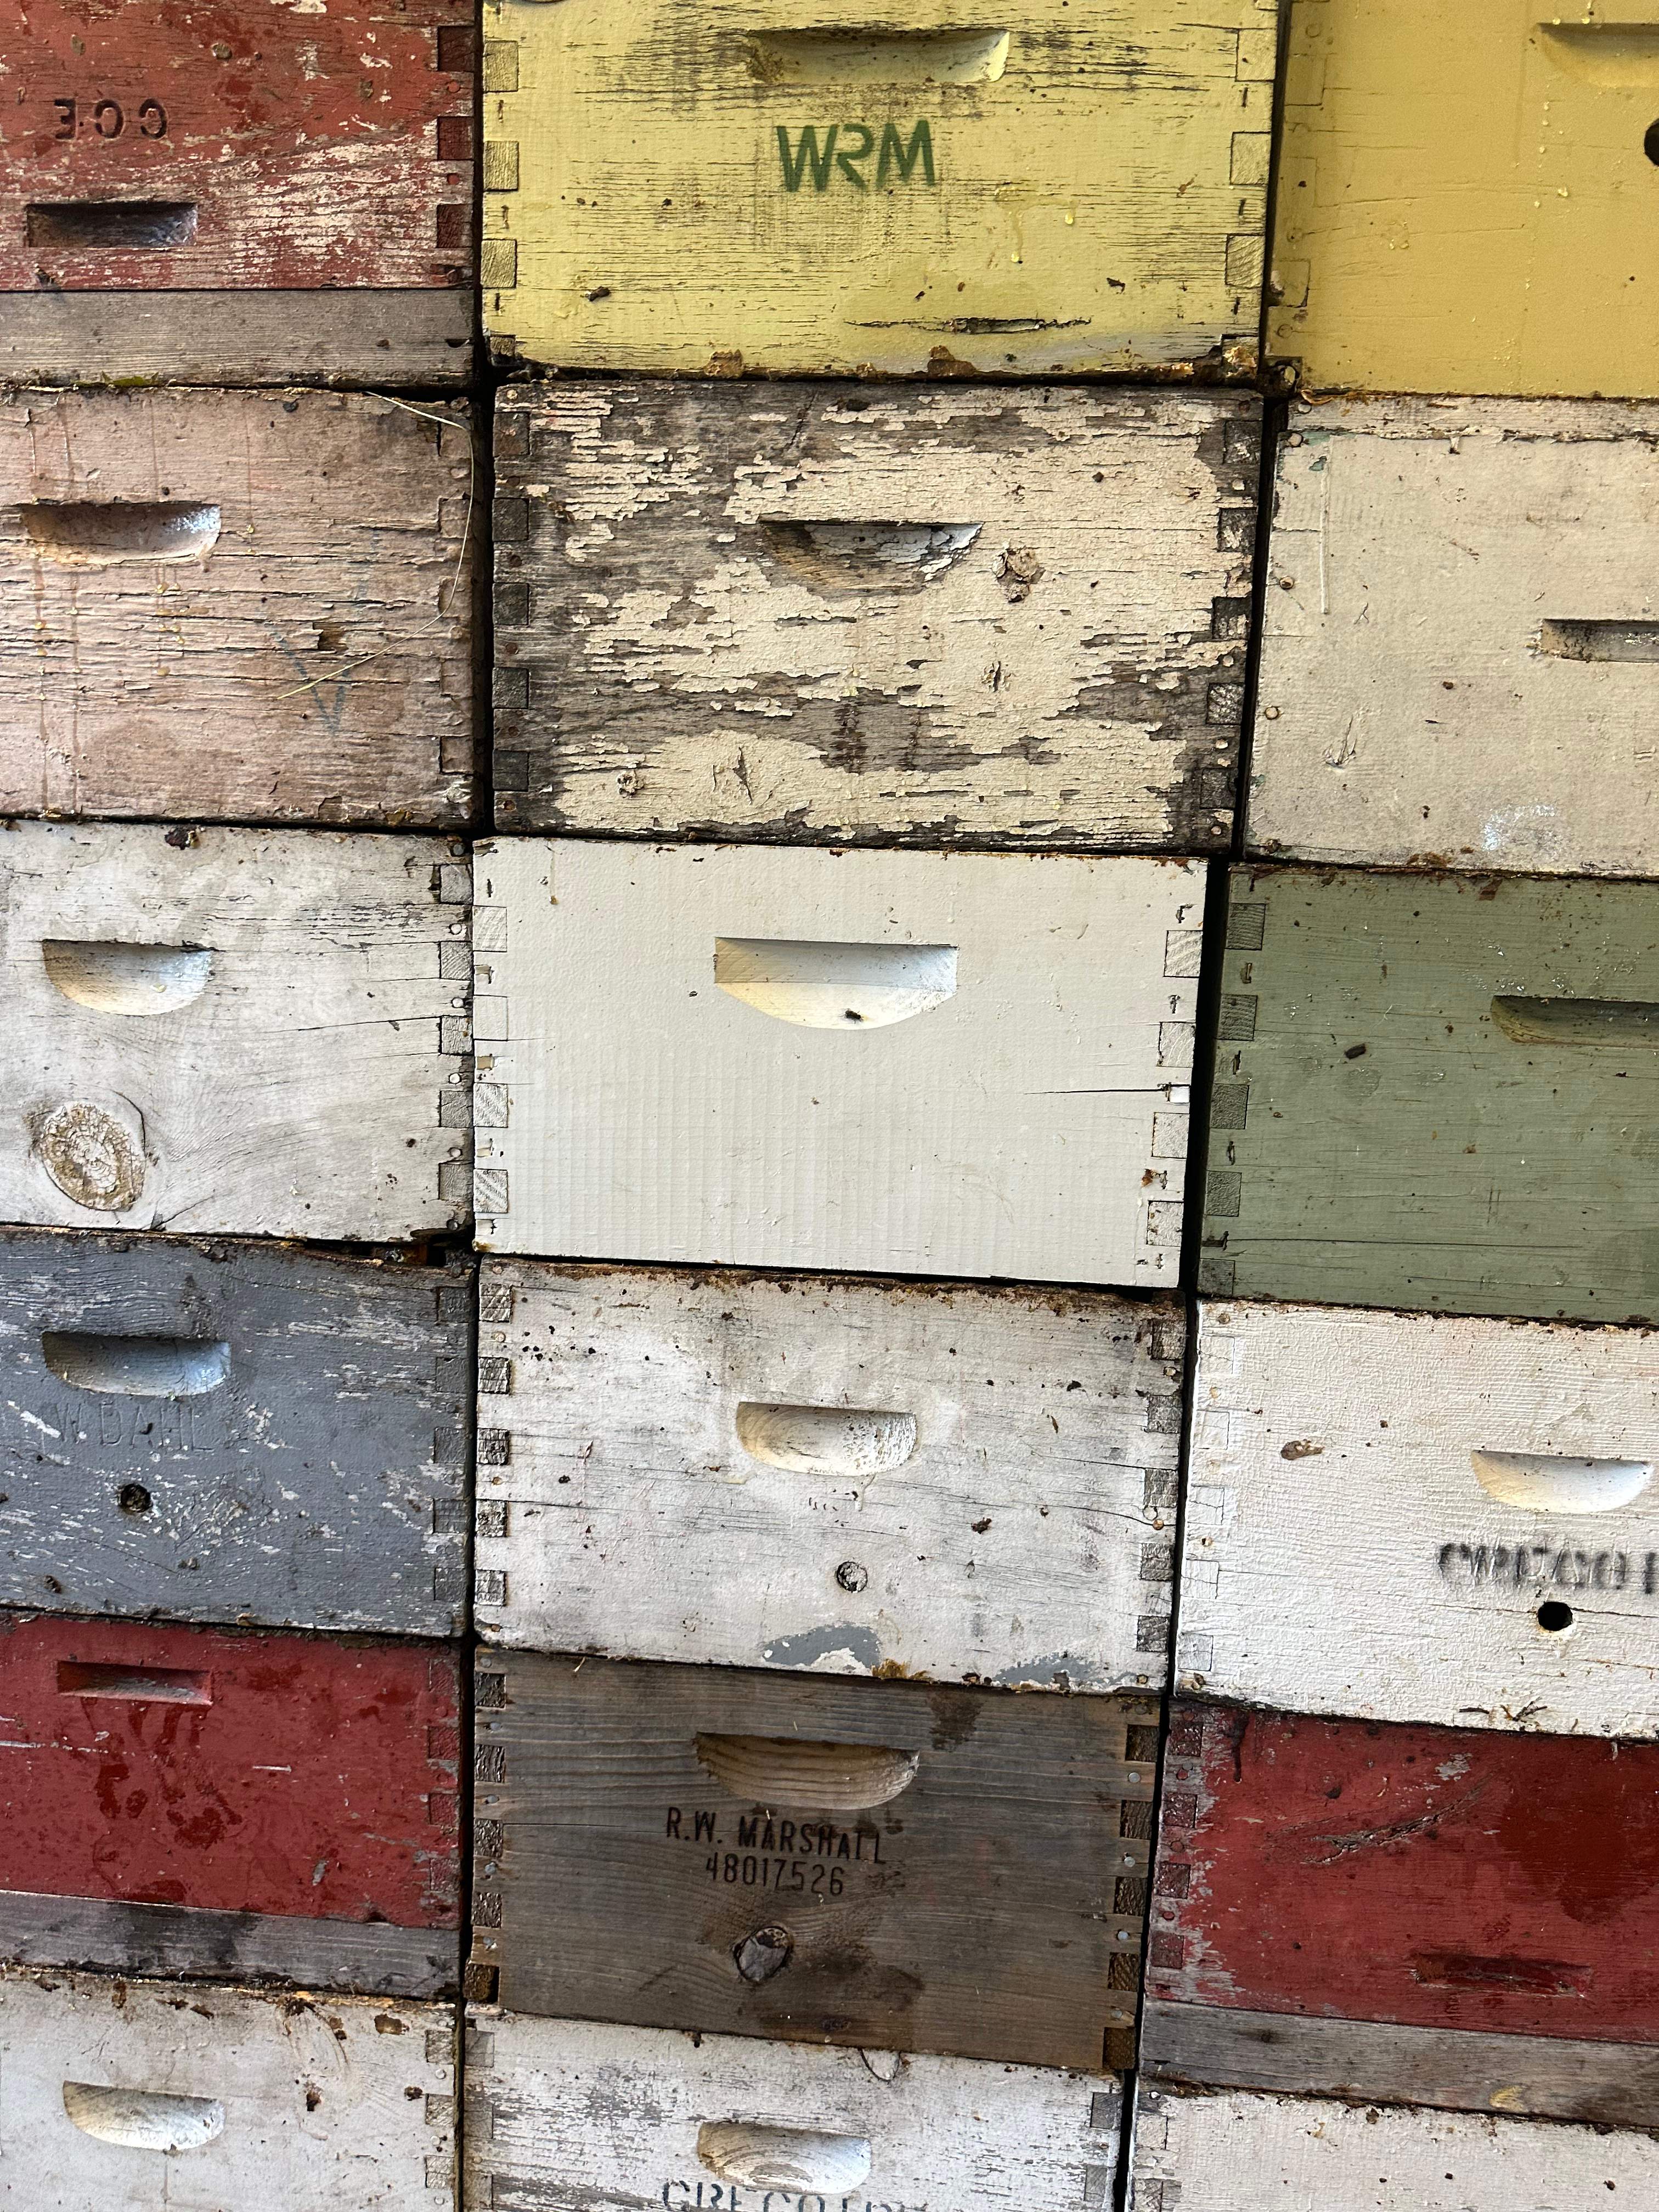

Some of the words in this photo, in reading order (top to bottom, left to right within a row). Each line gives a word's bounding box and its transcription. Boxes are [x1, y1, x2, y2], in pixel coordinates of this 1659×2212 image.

[777, 119, 935, 192] WRM
[666, 1806, 723, 1844] R.W.
[706, 1852, 844, 1897] 48017526
